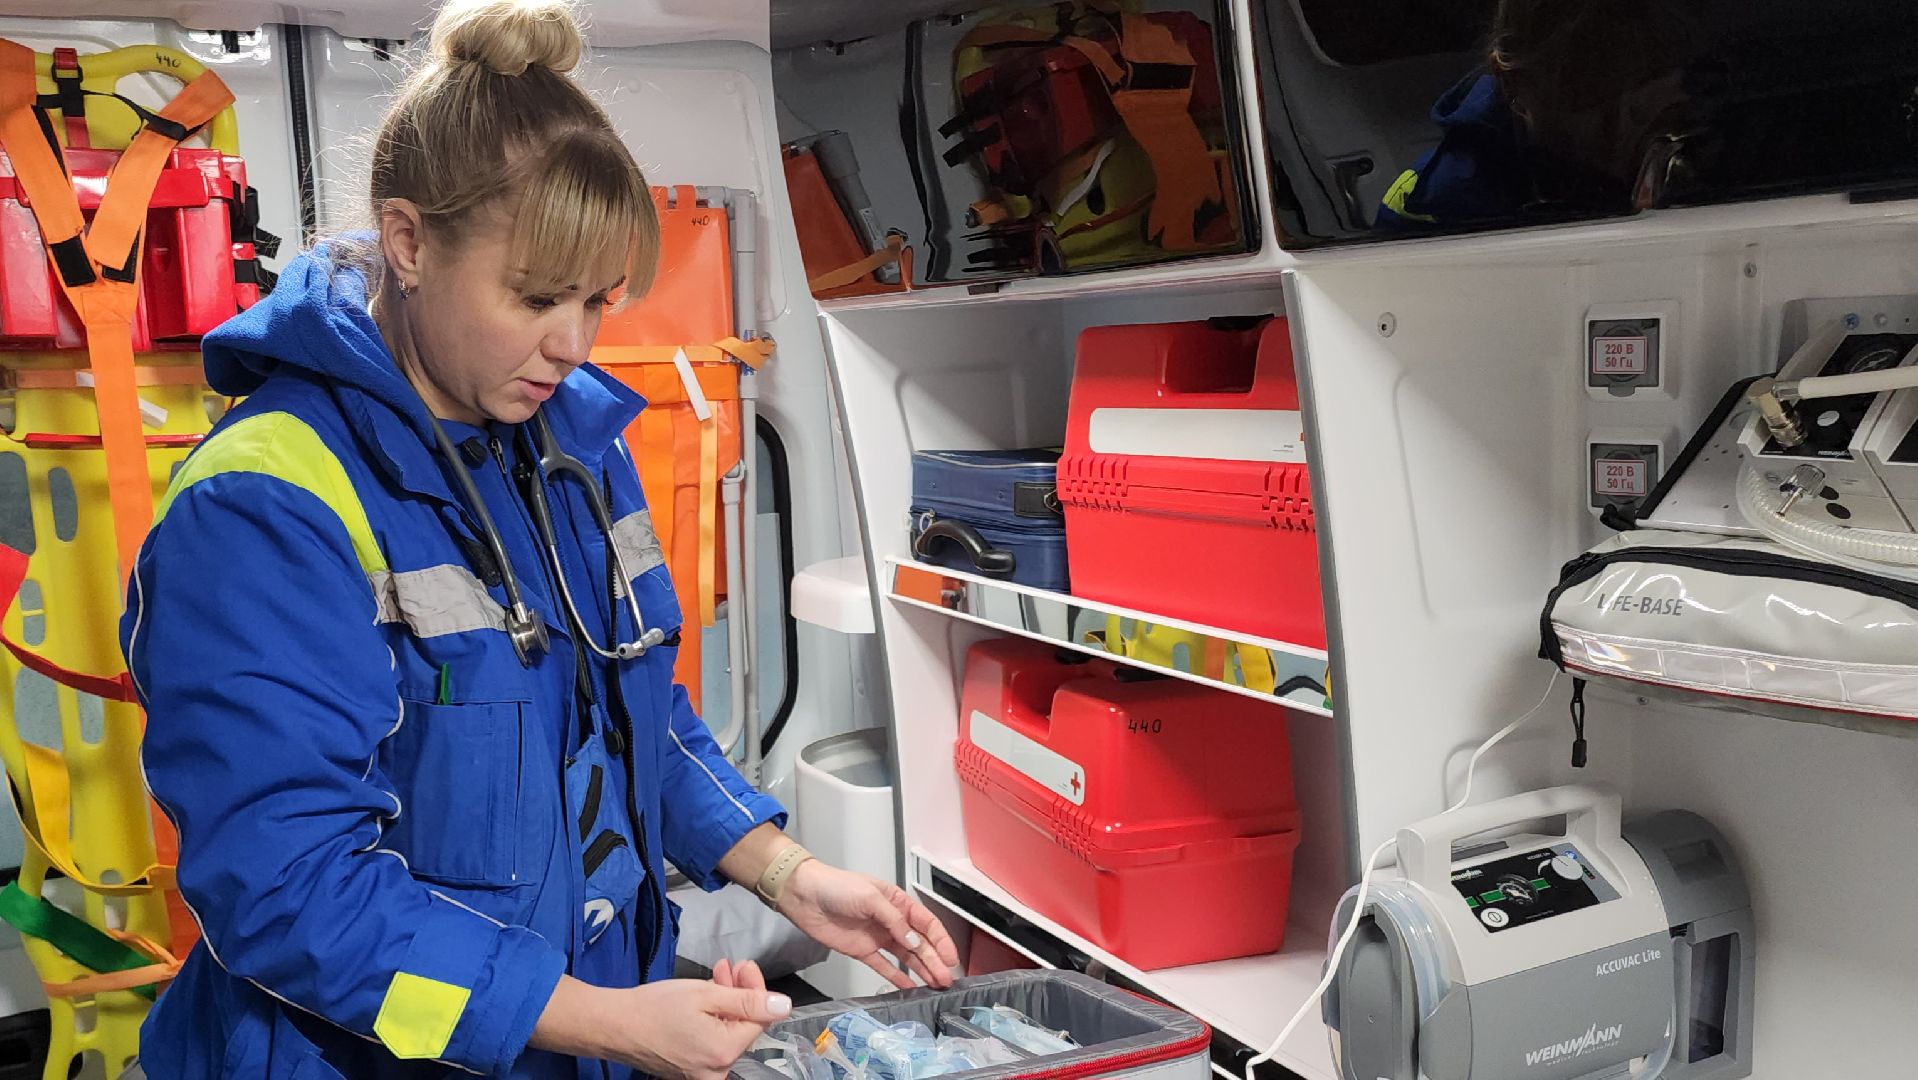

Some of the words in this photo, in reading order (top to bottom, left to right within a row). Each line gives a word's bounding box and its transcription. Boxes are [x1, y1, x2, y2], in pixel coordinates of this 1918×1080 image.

[691, 215, 710, 226] 440
[1605, 343, 1622, 354] 220
[1626, 343, 1634, 354] В
[1605, 356, 1617, 367] 50
[1606, 465, 1623, 477] 220
[1626, 465, 1634, 477] В
[1606, 478, 1618, 489] 50
[1621, 478, 1634, 491] Гц
[1597, 593, 1684, 616] LFE-BASE
[1128, 718, 1162, 734] 440
[1596, 953, 1641, 976] ACCUVAC
[1642, 949, 1661, 962] Lite
[1525, 1022, 1623, 1066] WEINMANN
